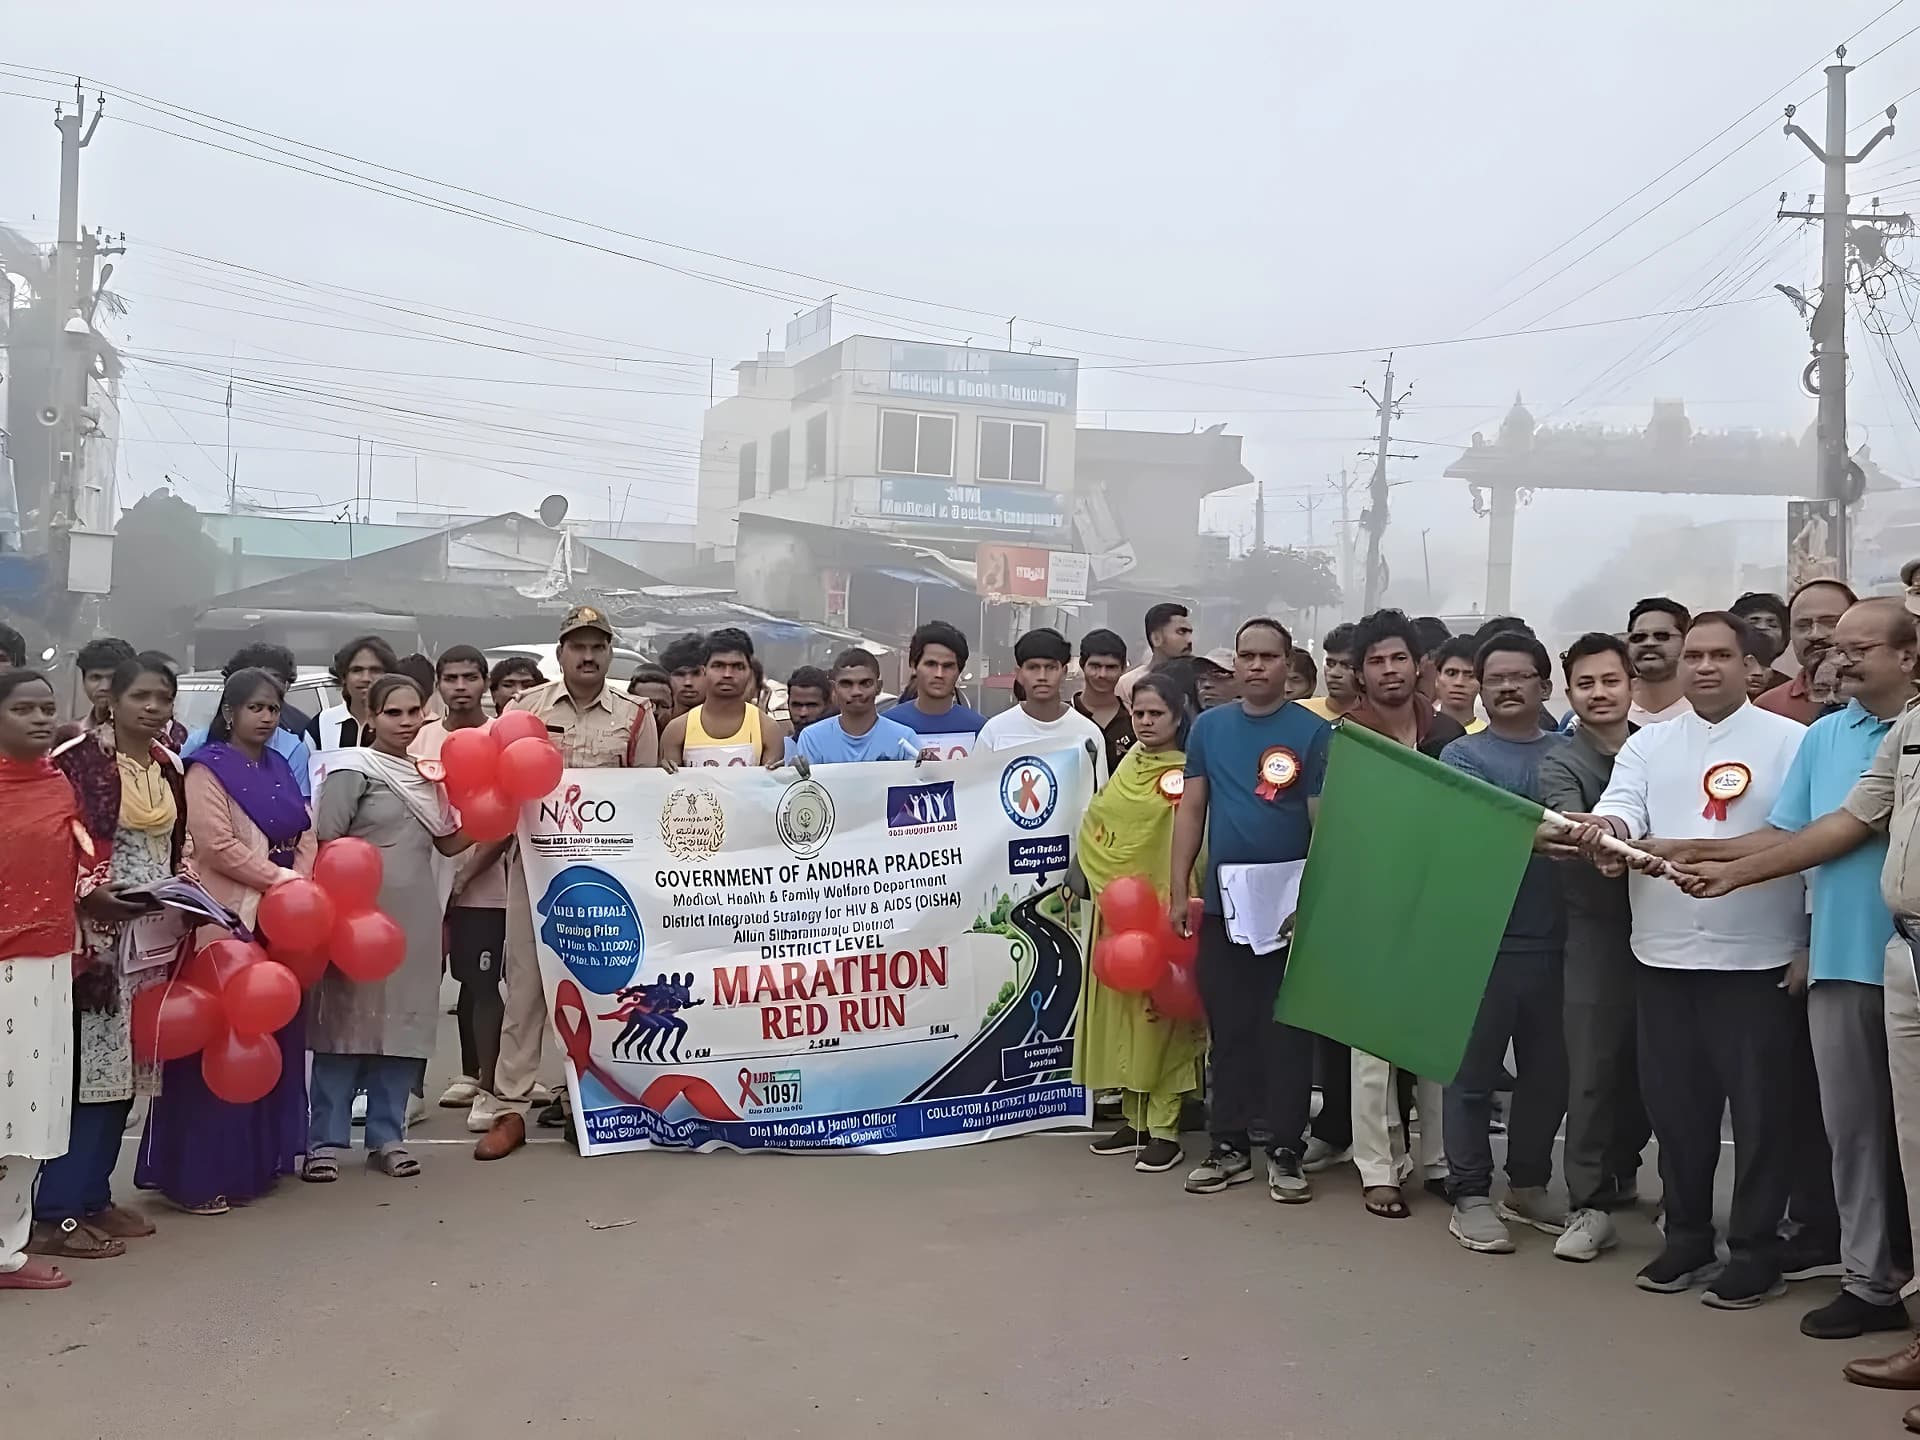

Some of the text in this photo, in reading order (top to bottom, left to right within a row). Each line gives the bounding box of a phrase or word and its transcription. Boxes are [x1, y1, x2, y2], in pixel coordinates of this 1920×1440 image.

[655, 847, 963, 888] GOVERNMENT OF ANDHRA PRADESH
[727, 891, 766, 905] Health
[769, 890, 778, 903] &
[782, 887, 820, 903] Family
[824, 883, 870, 899] Welfare
[873, 873, 947, 894] Department
[662, 891, 962, 929] District Integrated Strategy for HIV & AIDS (DISHA)
[480, 951, 491, 971] 6
[761, 934, 885, 960] DISTRICT LEVEL
[712, 946, 948, 1008] MARATHON
[761, 994, 907, 1040] RED RUN
[763, 1082, 799, 1105] 1097
